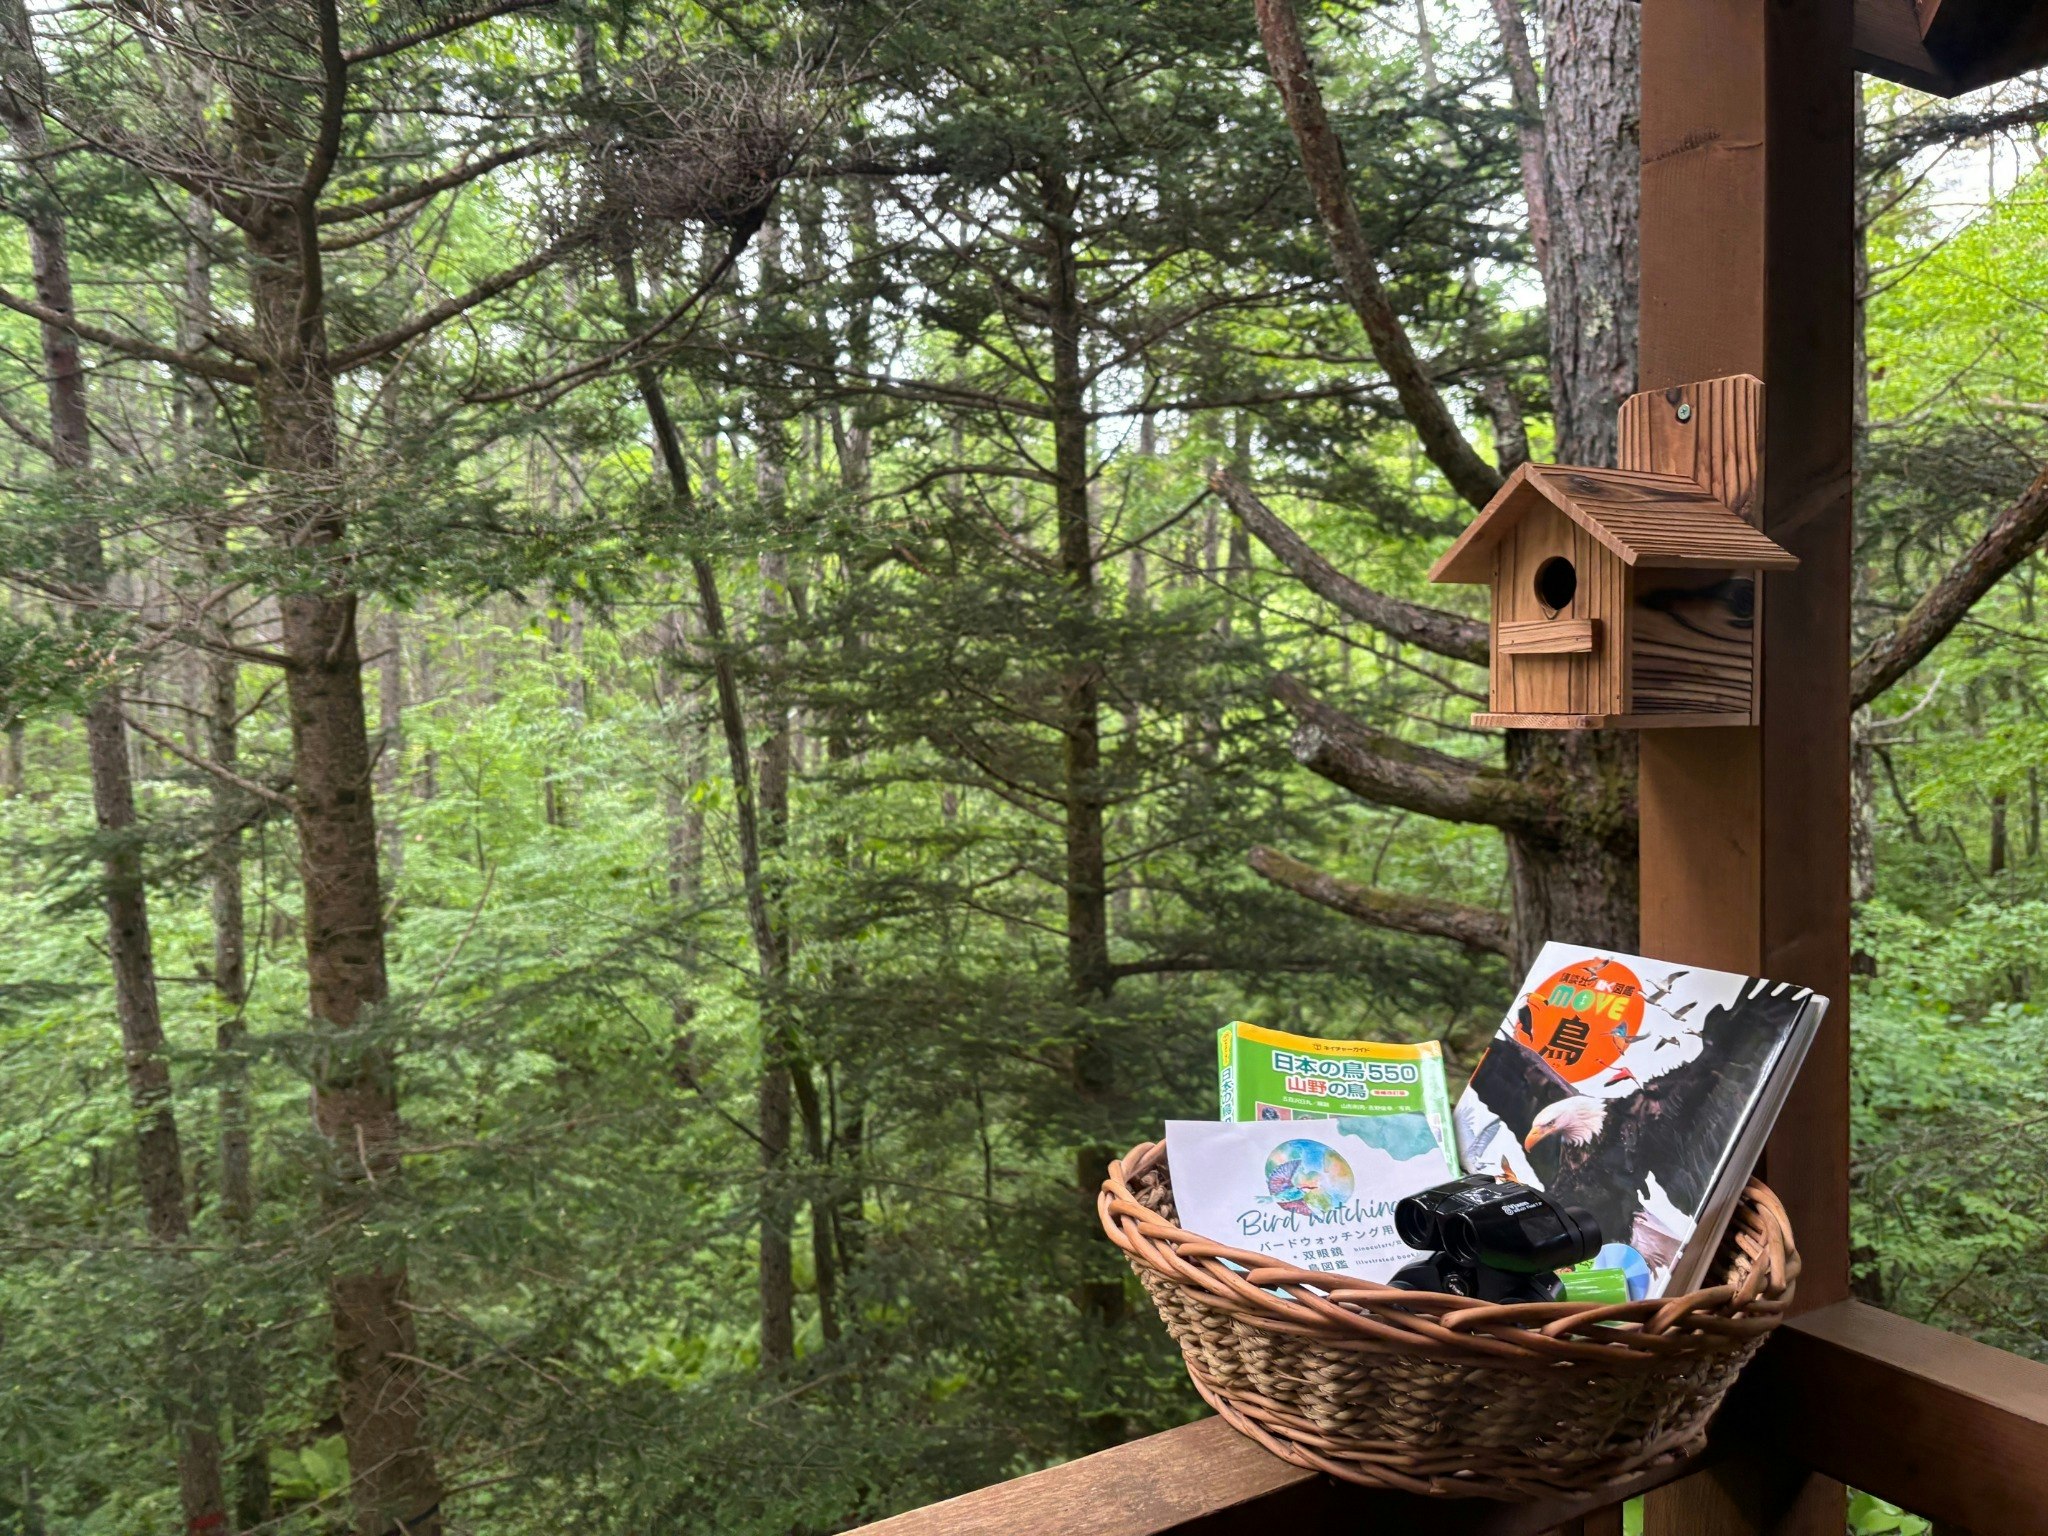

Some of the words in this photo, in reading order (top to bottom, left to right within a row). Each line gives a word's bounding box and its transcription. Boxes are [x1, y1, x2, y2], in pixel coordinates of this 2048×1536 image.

[1548, 984, 1631, 1022] MOVE
[1538, 1014, 1591, 1066] 鳥
[1274, 1053, 1418, 1082] 日本の鳥550
[1287, 1076, 1367, 1099] 山野の鳥
[1236, 1208, 1301, 1236] Bird
[1259, 1224, 1395, 1252] バードウォッチング用
